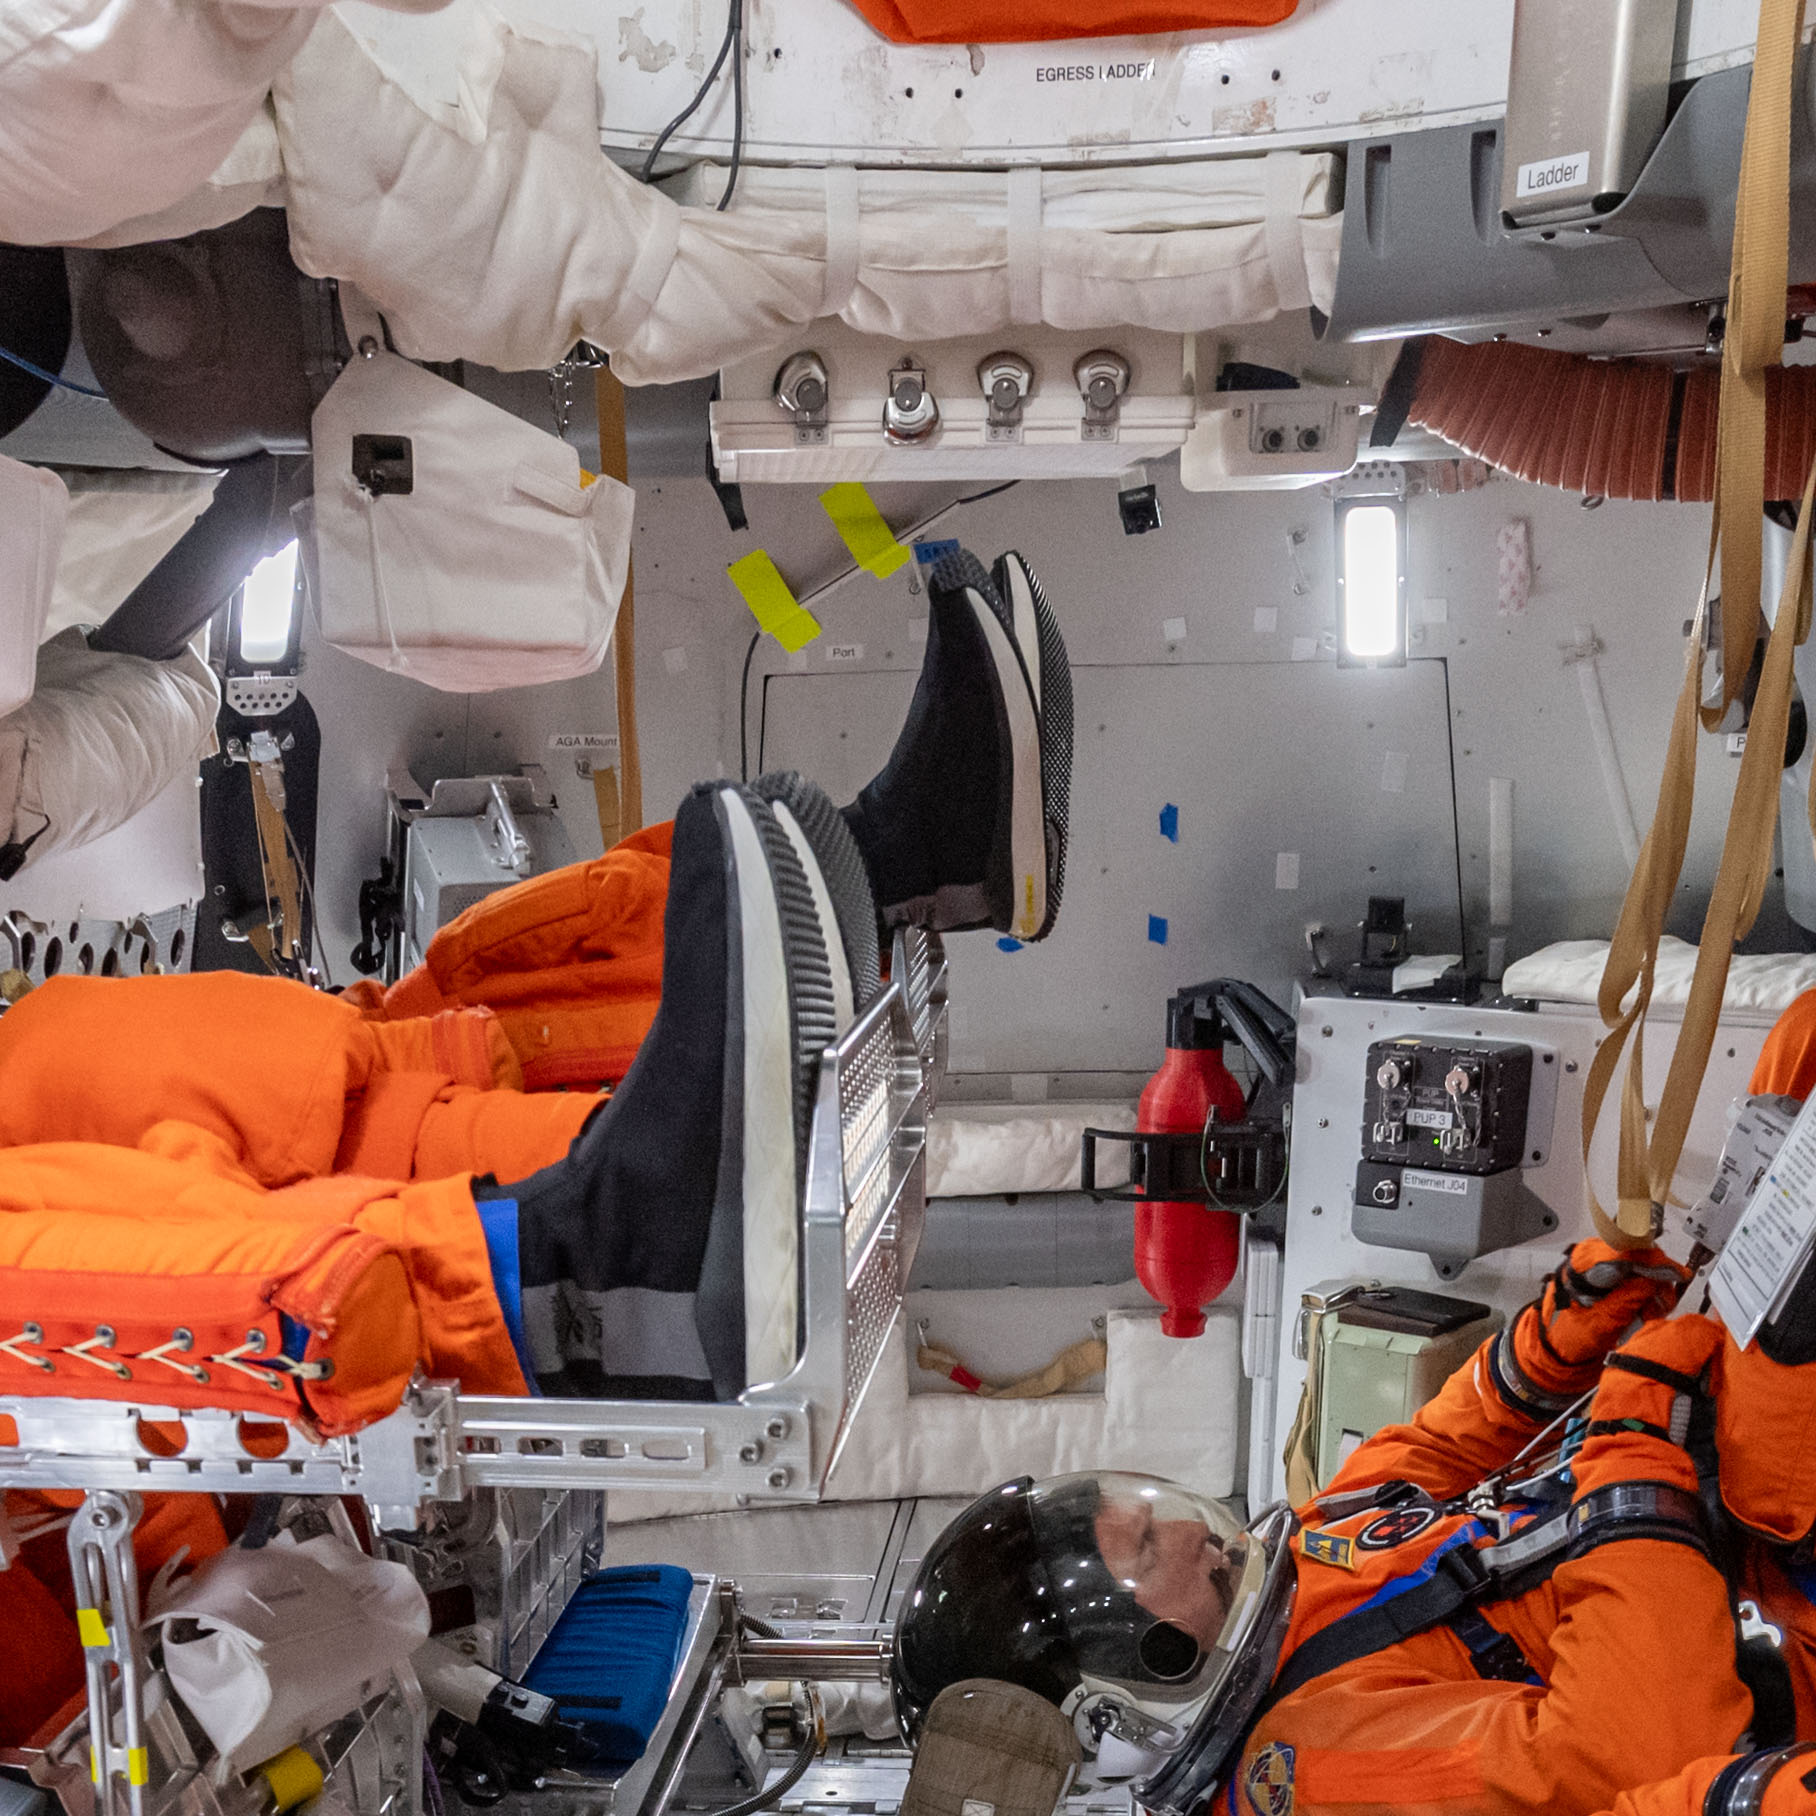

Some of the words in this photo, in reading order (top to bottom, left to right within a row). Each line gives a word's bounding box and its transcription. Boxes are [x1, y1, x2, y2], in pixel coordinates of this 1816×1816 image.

[1036, 66, 1094, 82] EGRESS
[1528, 163, 1579, 190] Ladder
[832, 647, 855, 658] Port
[555, 736, 581, 747] AGA
[1414, 1112, 1433, 1125] PUP
[1438, 1115, 1446, 1126] 3
[1404, 1174, 1446, 1189] Ethernet
